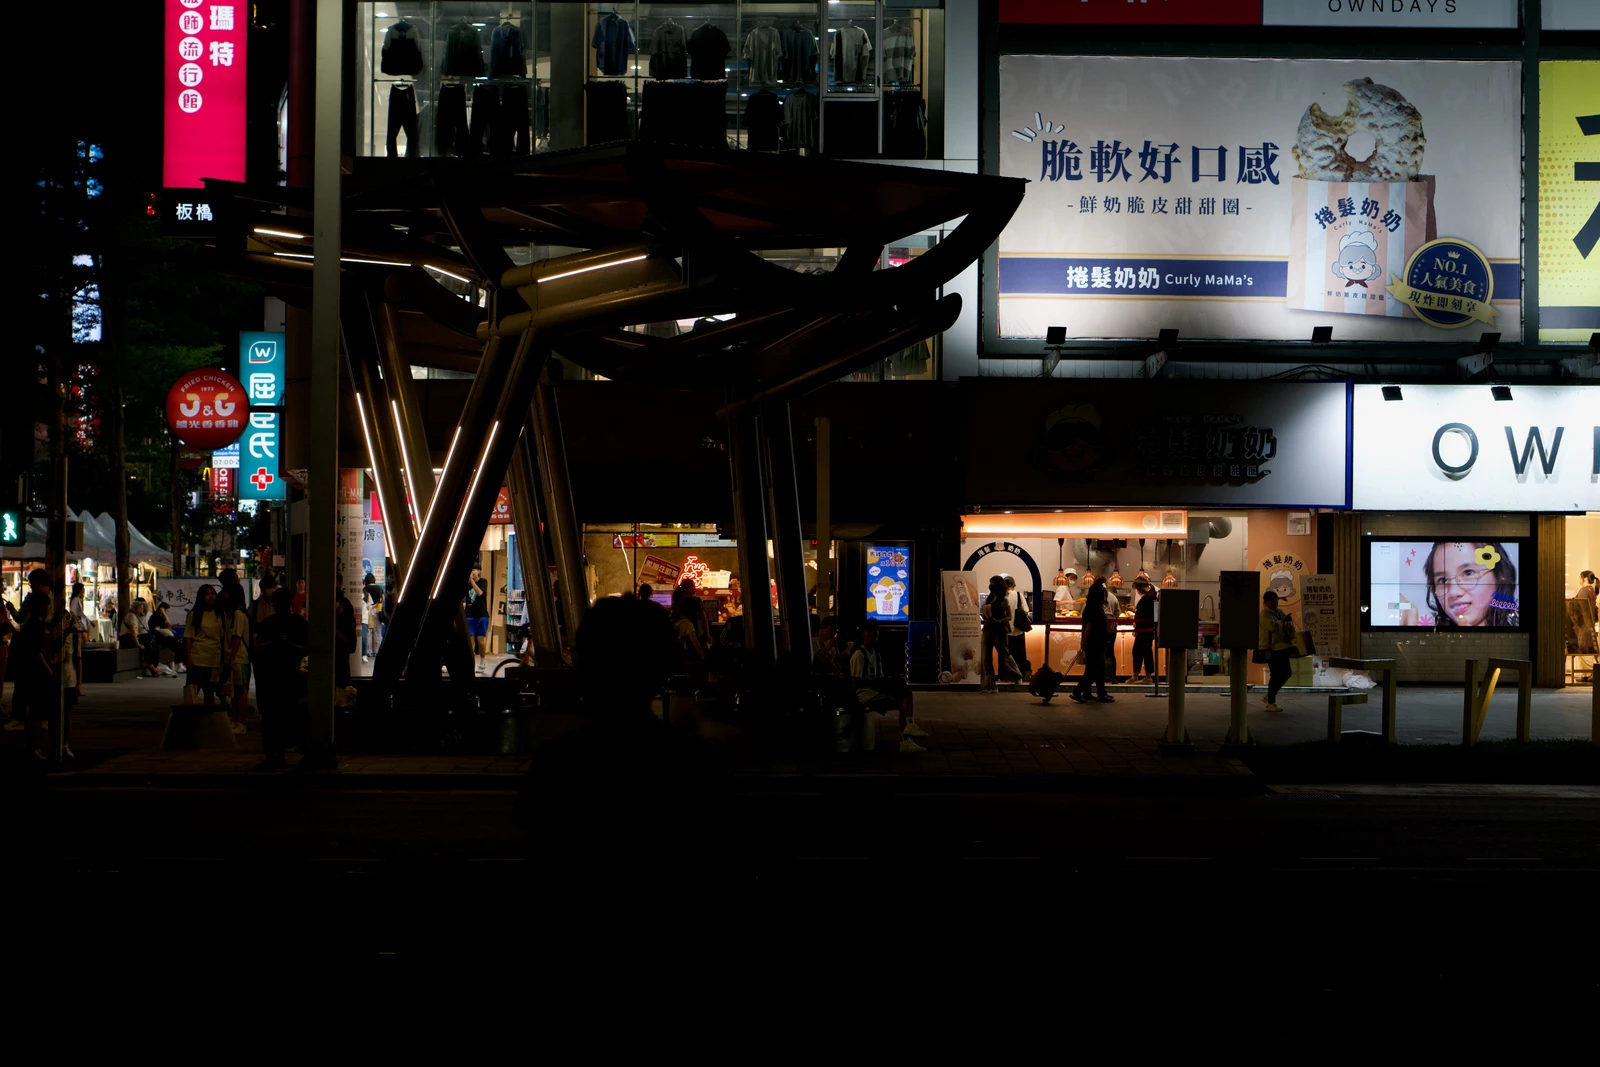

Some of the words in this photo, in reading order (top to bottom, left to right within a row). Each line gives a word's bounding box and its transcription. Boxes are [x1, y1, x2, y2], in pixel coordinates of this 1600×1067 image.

[1328, 0, 1457, 13] OWNDAYS
[209, 5, 234, 67] 瑪特
[181, 0, 201, 109] 飾流行館
[1040, 139, 1280, 186] 脆軟好口感
[176, 203, 213, 221] 板橋
[1315, 197, 1403, 233] 捲髮奶奶
[1067, 266, 1160, 289] 捲髮奶奶
[1165, 273, 1201, 287] Curly
[1205, 274, 1254, 286] MaMa's
[1433, 257, 1468, 276] NO.1
[1420, 271, 1477, 295] 人氣美食
[1408, 290, 1477, 313] 現炸即刻享
[180, 376, 201, 392] FRIED
[203, 375, 235, 392] CHICKEN
[179, 393, 236, 418] J&G
